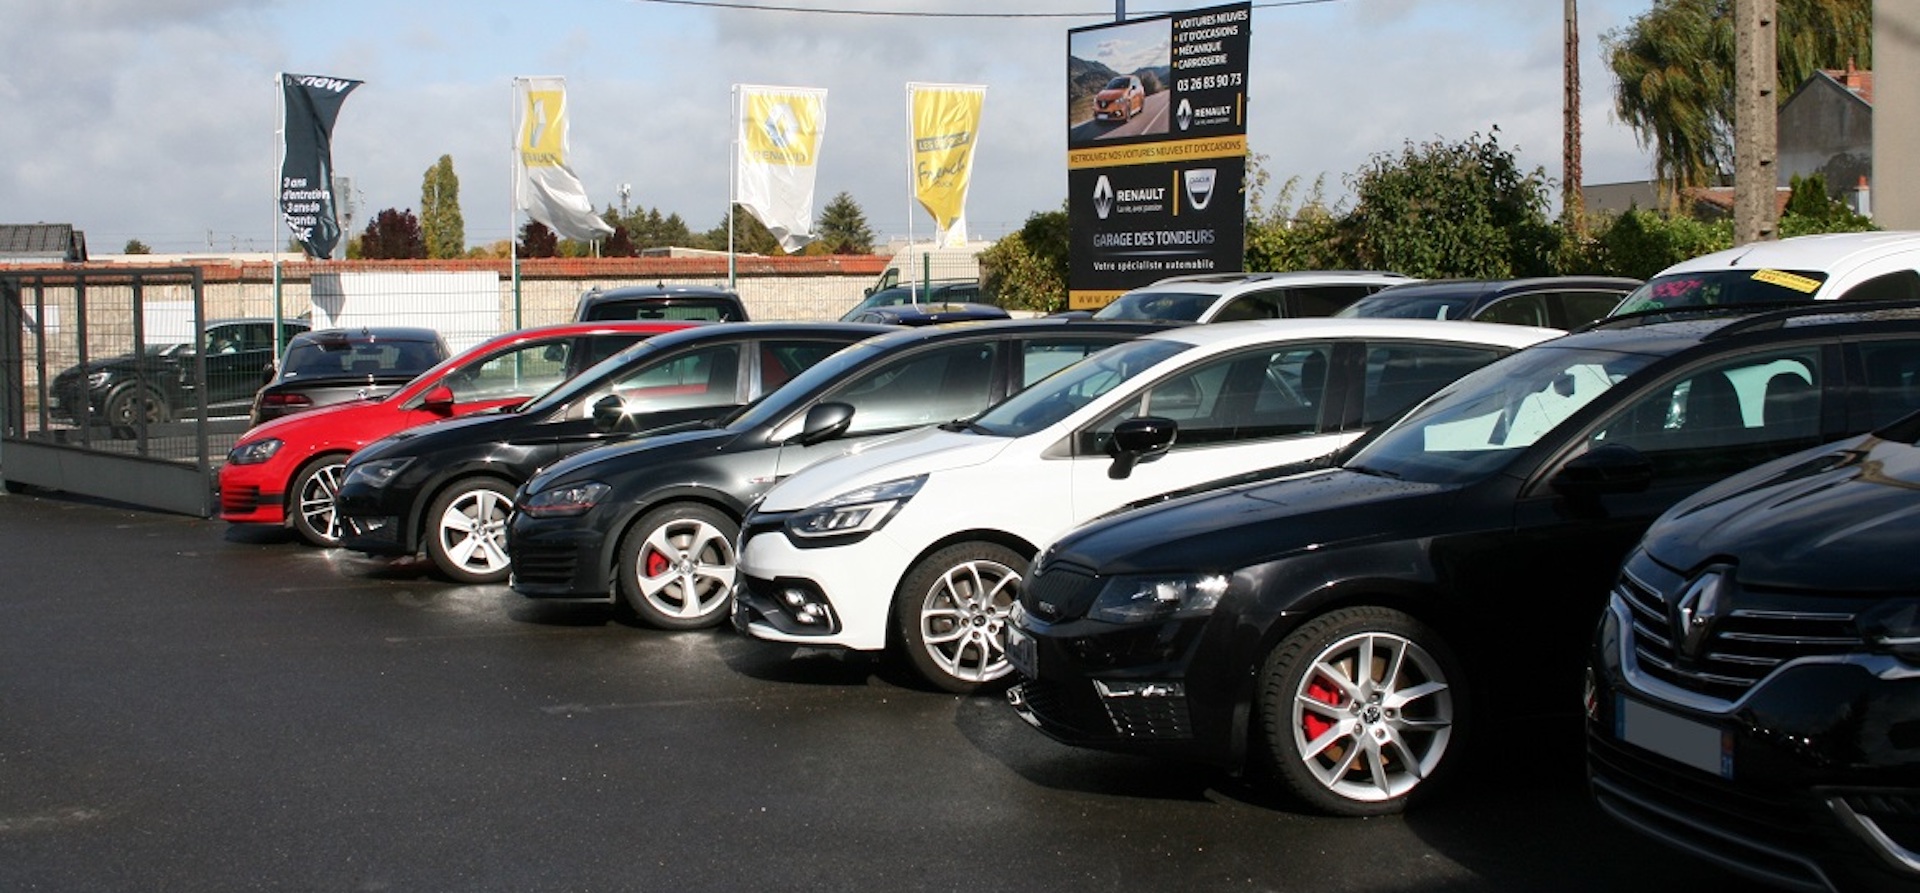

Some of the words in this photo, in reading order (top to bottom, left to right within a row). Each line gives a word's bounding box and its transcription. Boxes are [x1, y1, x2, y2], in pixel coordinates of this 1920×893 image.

[1179, 15, 1216, 29] VOITURES
[1217, 10, 1248, 24] NEUVES
[1179, 32, 1189, 43] ET
[1189, 25, 1238, 42] D'OCCASIONS
[1178, 54, 1228, 70] CARROSSERIE
[1177, 79, 1189, 92] 03
[1190, 78, 1202, 91] 26
[1203, 77, 1215, 89] 83
[1217, 75, 1229, 88] 90
[1230, 73, 1242, 86] 73
[1194, 105, 1232, 118] RENAULT
[1070, 152, 1107, 163] RETROUVEZ
[1108, 150, 1122, 160] NOS
[1123, 147, 1155, 159] VOITURES
[1156, 145, 1183, 156] NEUVES
[1184, 144, 1192, 153] ET
[1194, 141, 1241, 153] D'OCCASIONS
[291, 178, 307, 188] ans
[1116, 188, 1165, 202] RENAULT
[1093, 232, 1133, 247] GARAGE
[1134, 233, 1155, 246] DES
[1156, 229, 1215, 245] TONDEURS
[1093, 261, 1115, 271] Votre
[1118, 260, 1163, 272] spécialiste
[1165, 258, 1214, 270] automobile
